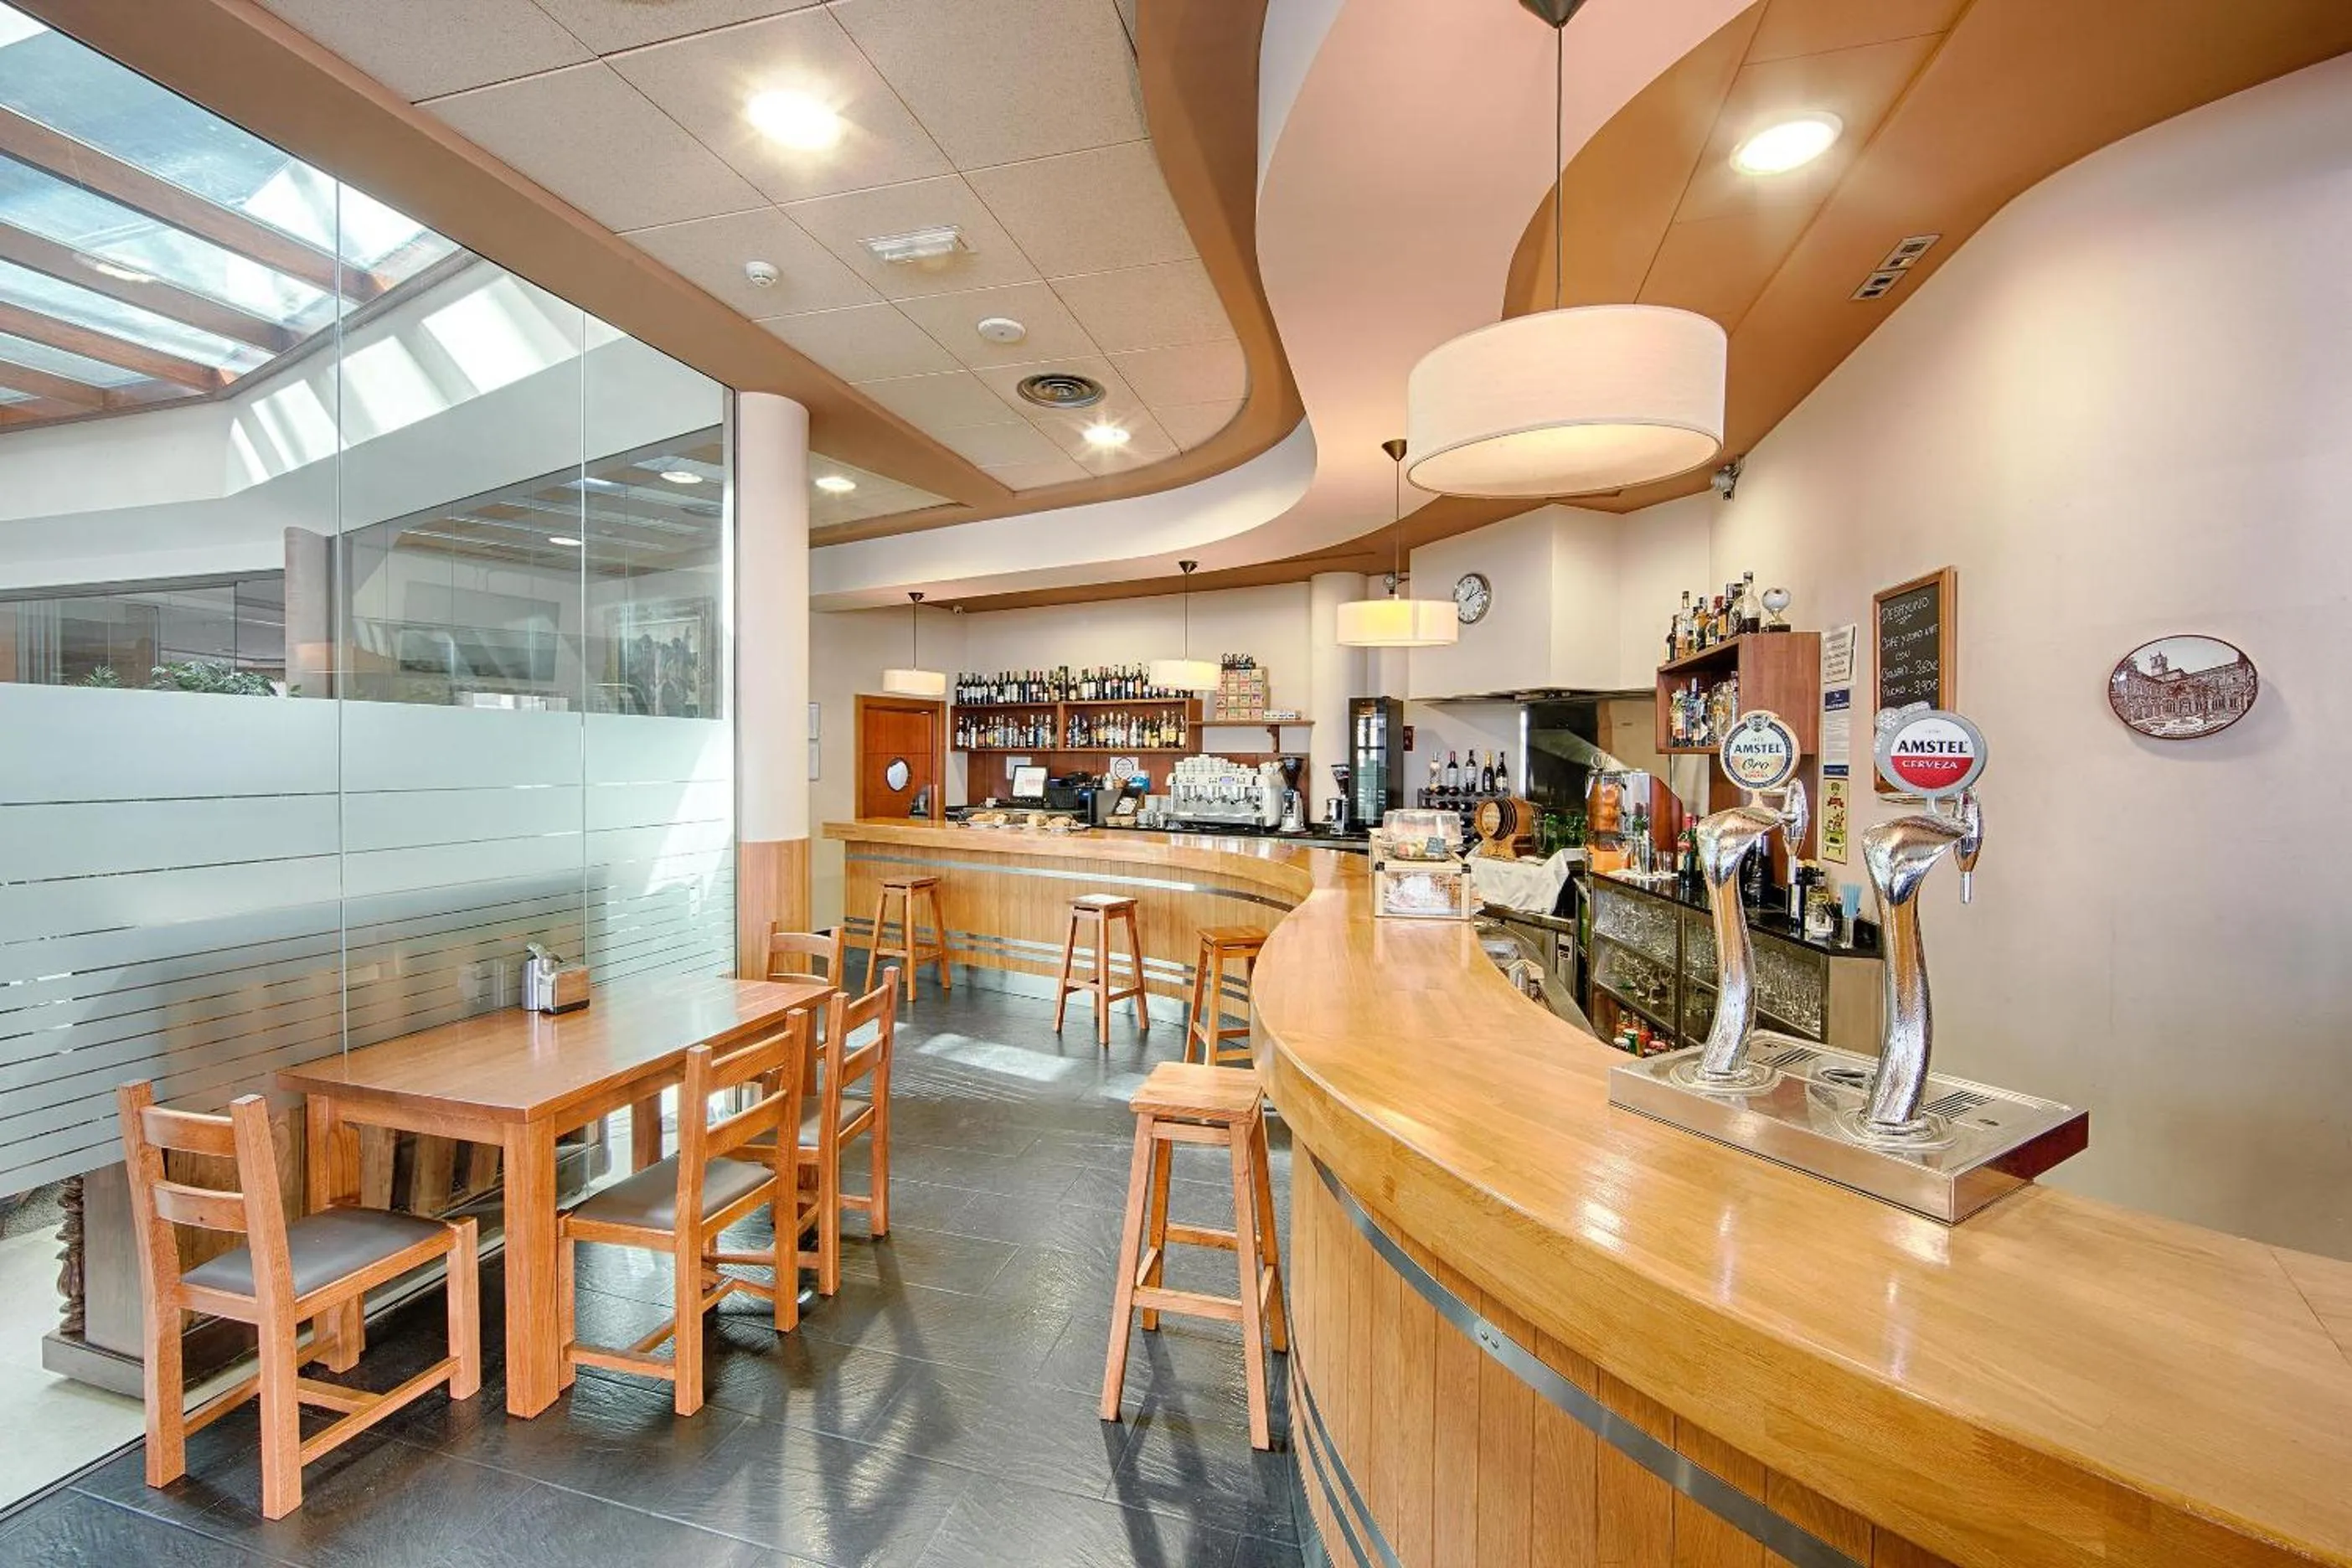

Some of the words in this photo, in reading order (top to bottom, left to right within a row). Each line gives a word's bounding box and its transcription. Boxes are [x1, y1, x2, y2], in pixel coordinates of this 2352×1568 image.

[1734, 744, 1782, 754] AMSTEL
[1896, 740, 1968, 753] AMSTEL
[1742, 758, 1770, 771] Oro
[1901, 760, 1957, 769] CERVEZA
